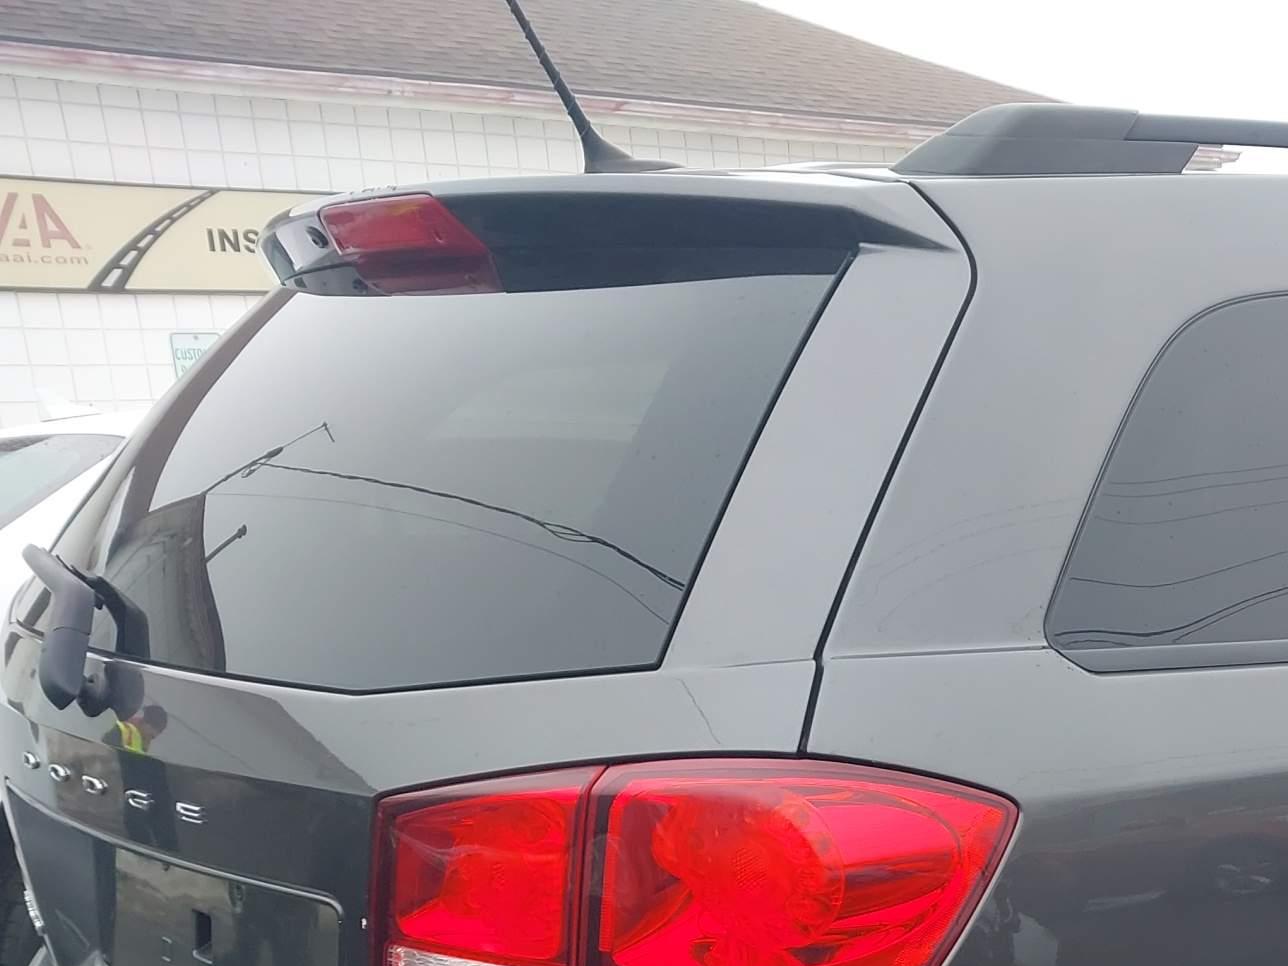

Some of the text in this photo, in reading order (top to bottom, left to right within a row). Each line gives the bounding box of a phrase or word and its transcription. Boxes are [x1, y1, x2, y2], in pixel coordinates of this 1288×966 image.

[206, 228, 259, 253] INS
[0, 252, 89, 265] aai.com
[175, 348, 204, 361] CUSTO
[24, 751, 207, 824] DODGE
